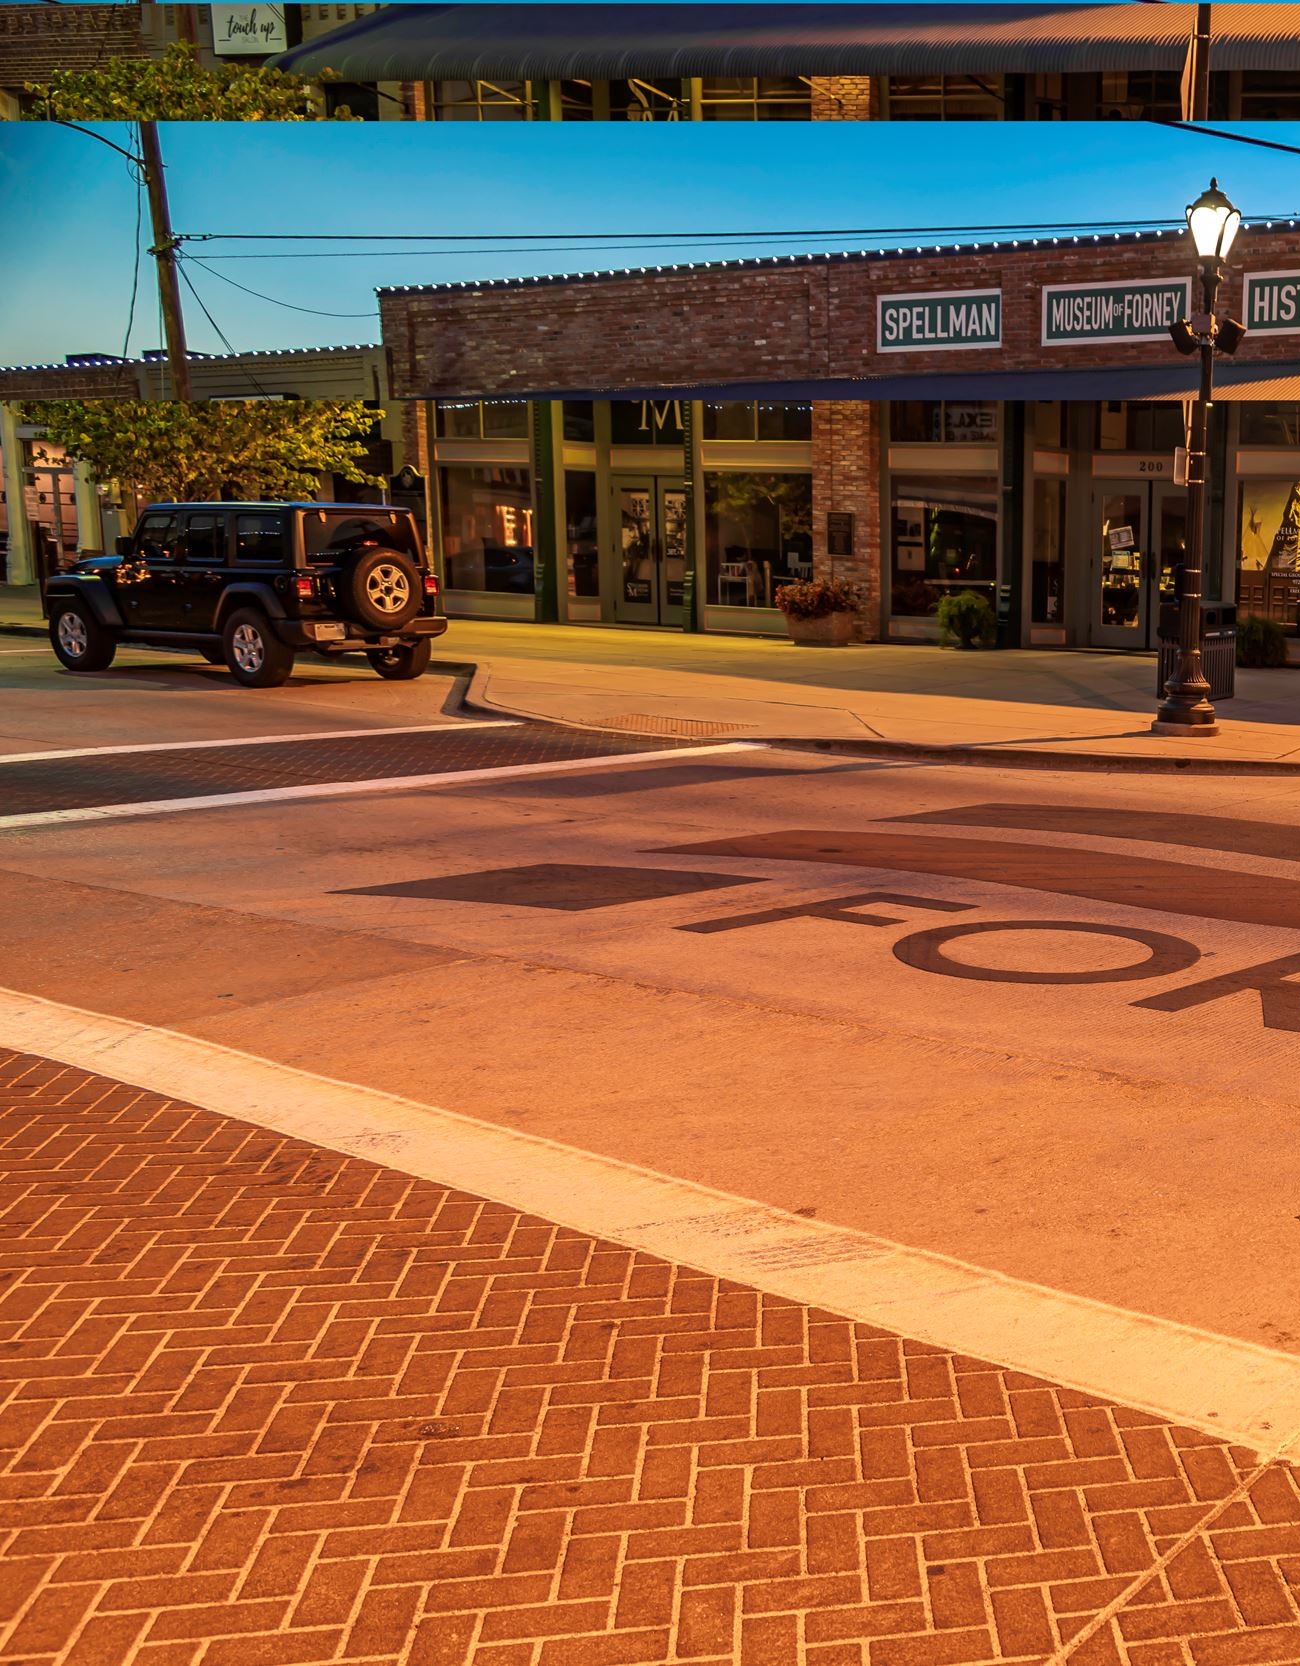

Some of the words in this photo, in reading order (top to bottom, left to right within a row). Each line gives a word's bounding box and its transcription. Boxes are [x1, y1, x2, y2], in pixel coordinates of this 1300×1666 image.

[226, 8, 257, 38] touch
[260, 22, 275, 43] up
[885, 303, 996, 341] SPELLMAN
[1052, 295, 1113, 332] MUSEUM
[1113, 303, 1124, 317] OF
[1124, 291, 1181, 328] FORNEY
[1139, 461, 1163, 472] 200
